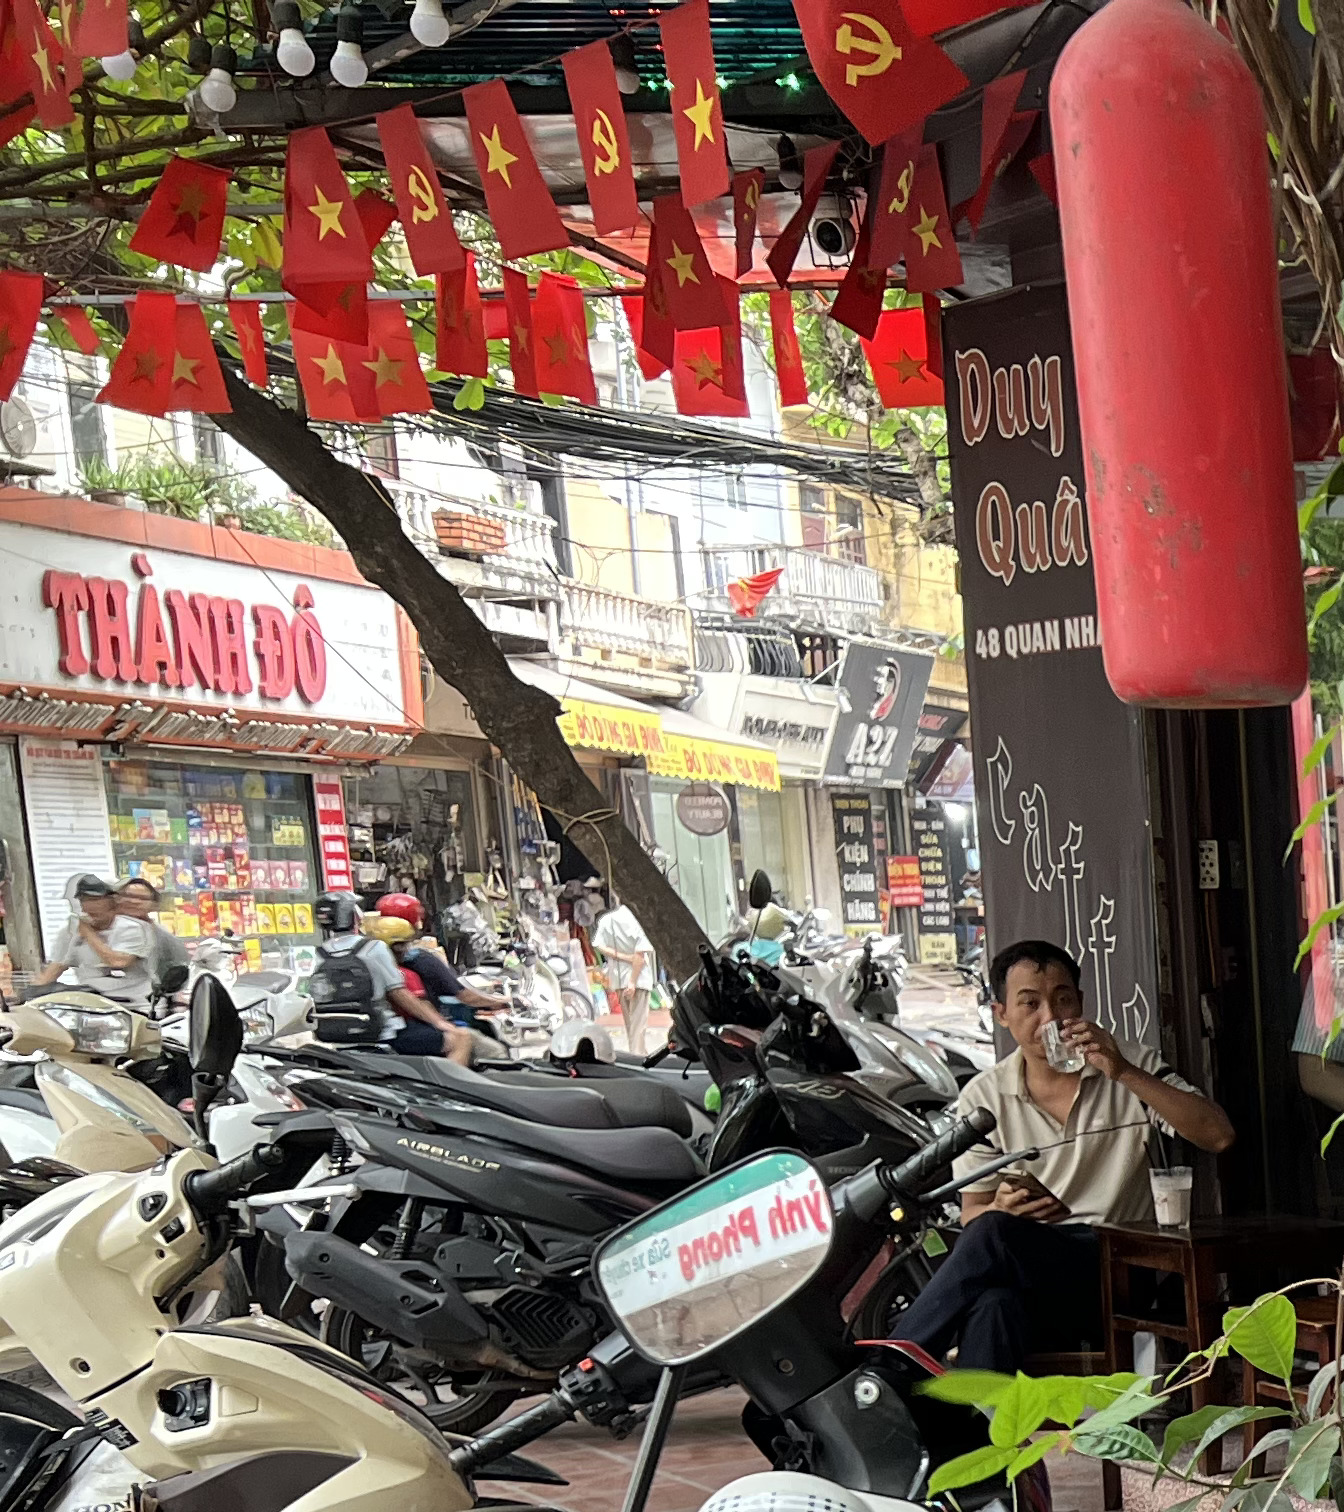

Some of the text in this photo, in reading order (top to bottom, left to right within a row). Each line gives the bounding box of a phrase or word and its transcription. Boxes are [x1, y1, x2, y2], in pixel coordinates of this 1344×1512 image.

[955, 347, 1064, 458] Duy
[974, 475, 1090, 587] Quâ
[42, 552, 328, 704] THÀNH ĐÔ
[975, 627, 1001, 659] 48
[1004, 619, 1061, 659] QUAN
[396, 1137, 501, 1171] AIRBLADE
